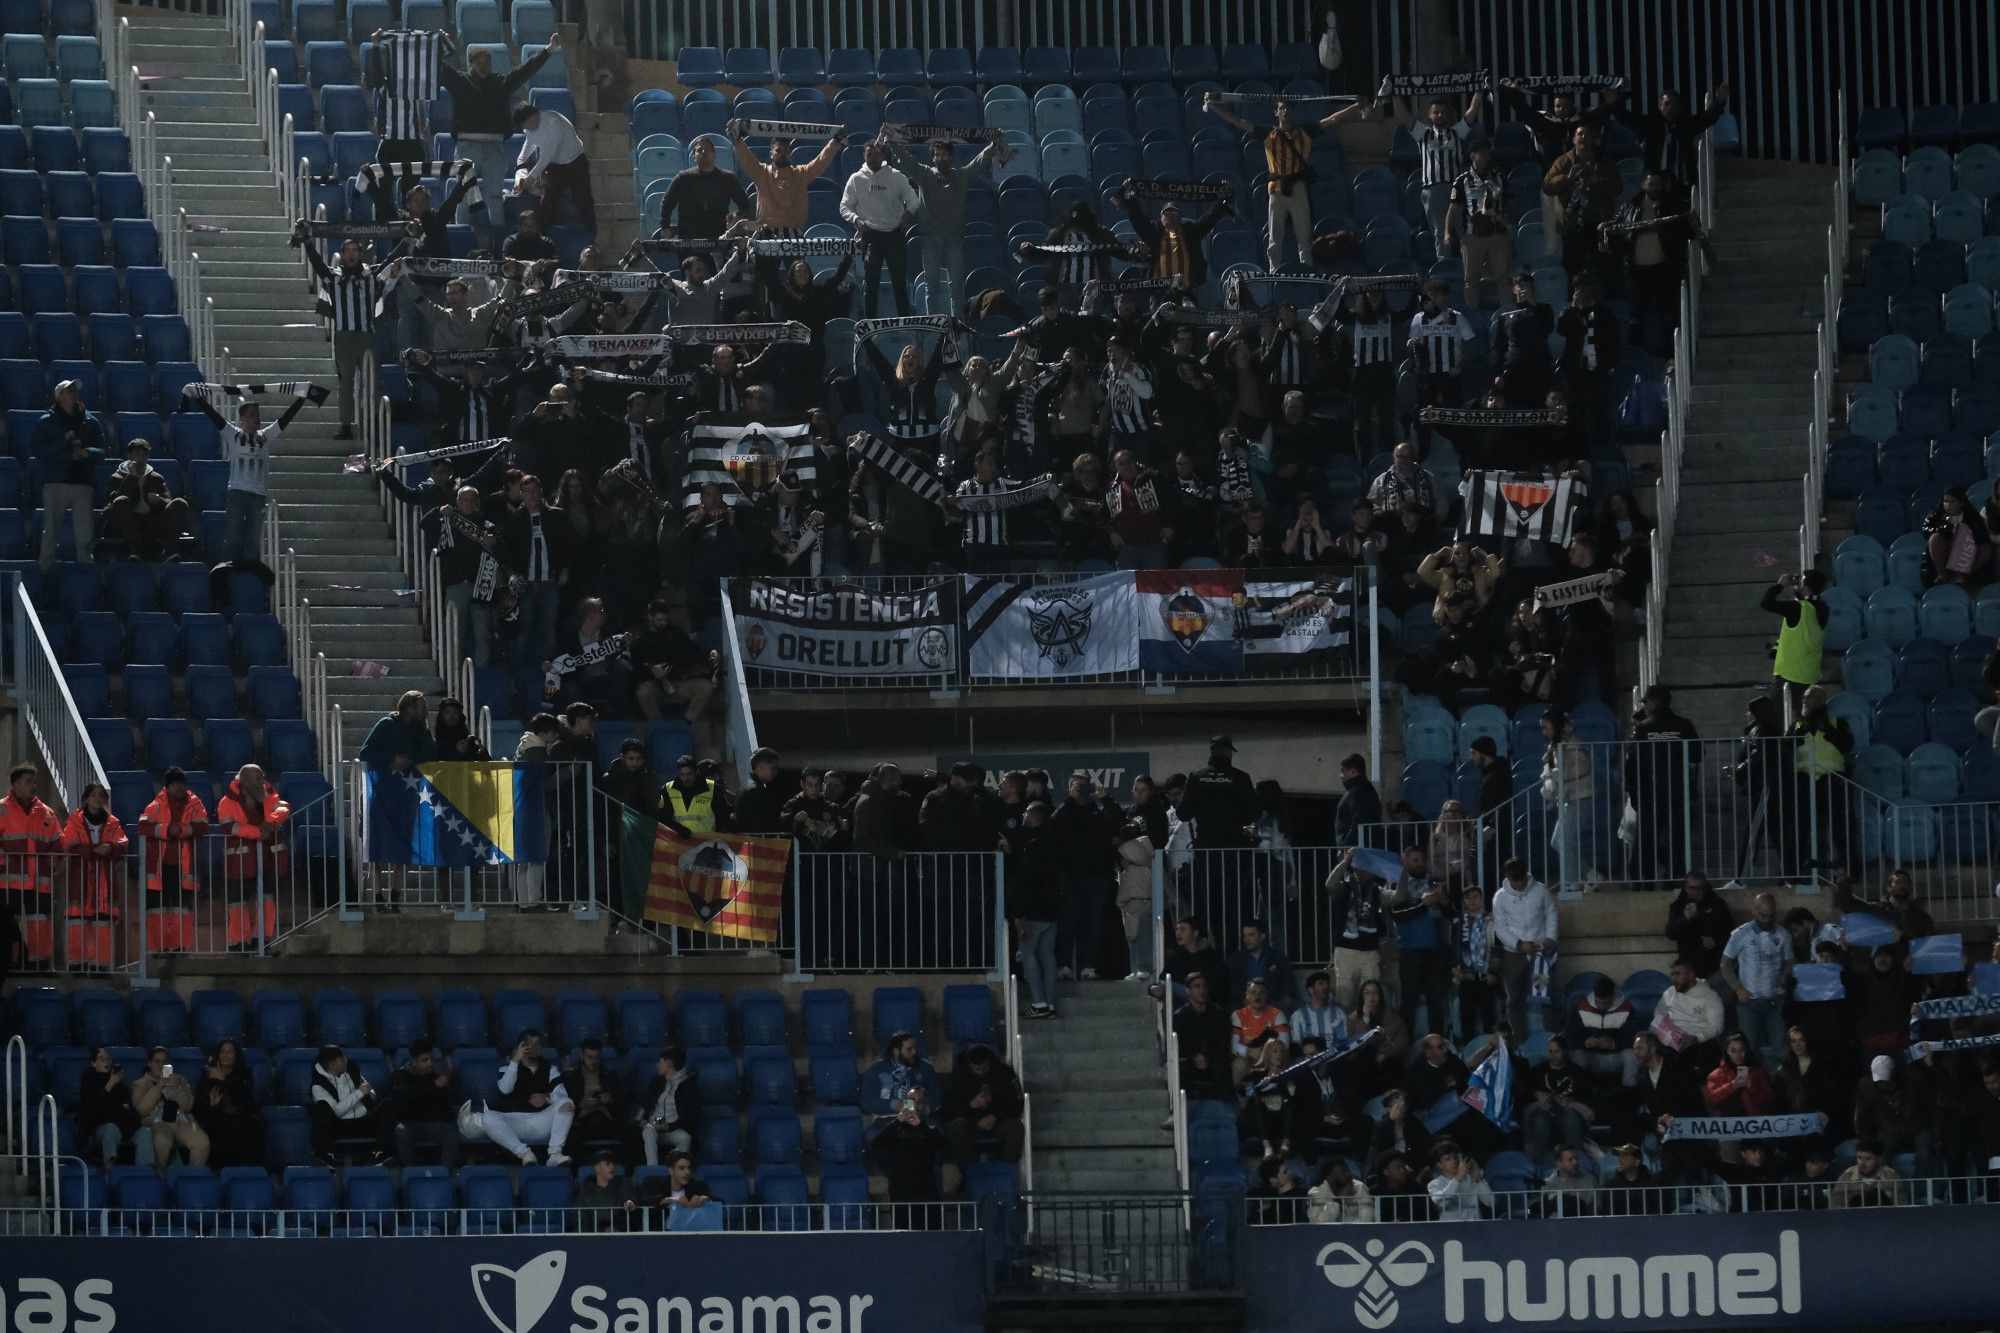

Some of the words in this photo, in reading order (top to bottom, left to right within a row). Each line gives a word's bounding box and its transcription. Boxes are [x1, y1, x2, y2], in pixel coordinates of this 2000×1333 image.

[1394, 75, 1408, 86] MI
[1426, 74, 1450, 86] LATE
[1450, 72, 1471, 84] POR
[1168, 183, 1228, 194] CASTELLO
[873, 317, 900, 329] PAM
[778, 632, 910, 668] ORELLUT
[1443, 1229, 1802, 1324] hummel
[570, 1284, 875, 1333] Sanamar
